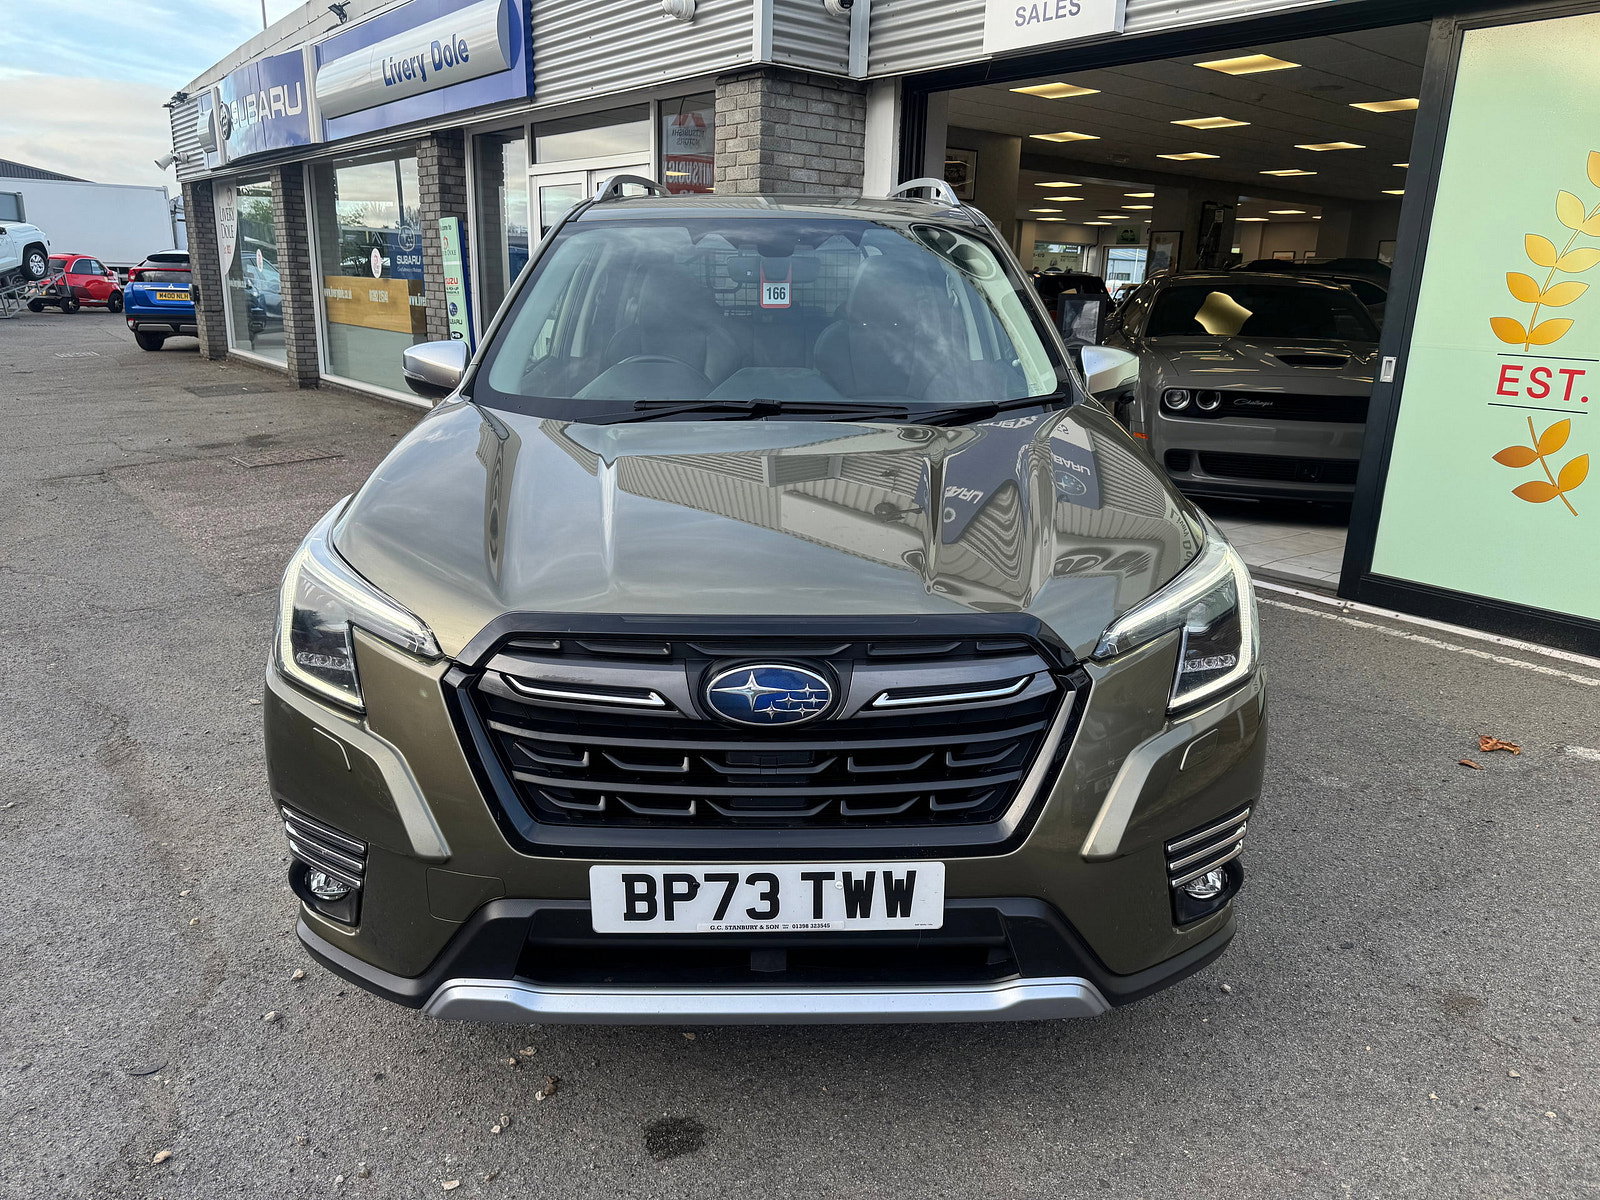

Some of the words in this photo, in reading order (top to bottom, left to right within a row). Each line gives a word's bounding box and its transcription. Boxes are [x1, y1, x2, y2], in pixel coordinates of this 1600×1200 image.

[1014, 0, 1081, 27] SALES
[382, 54, 427, 87] Livery
[430, 33, 470, 72] Dole
[230, 81, 302, 131] SUBARU
[396, 255, 422, 265] SUBARU
[766, 286, 787, 300] 166
[1496, 363, 1590, 404] EST.
[621, 872, 780, 922] BP73
[800, 869, 917, 920] TWW
